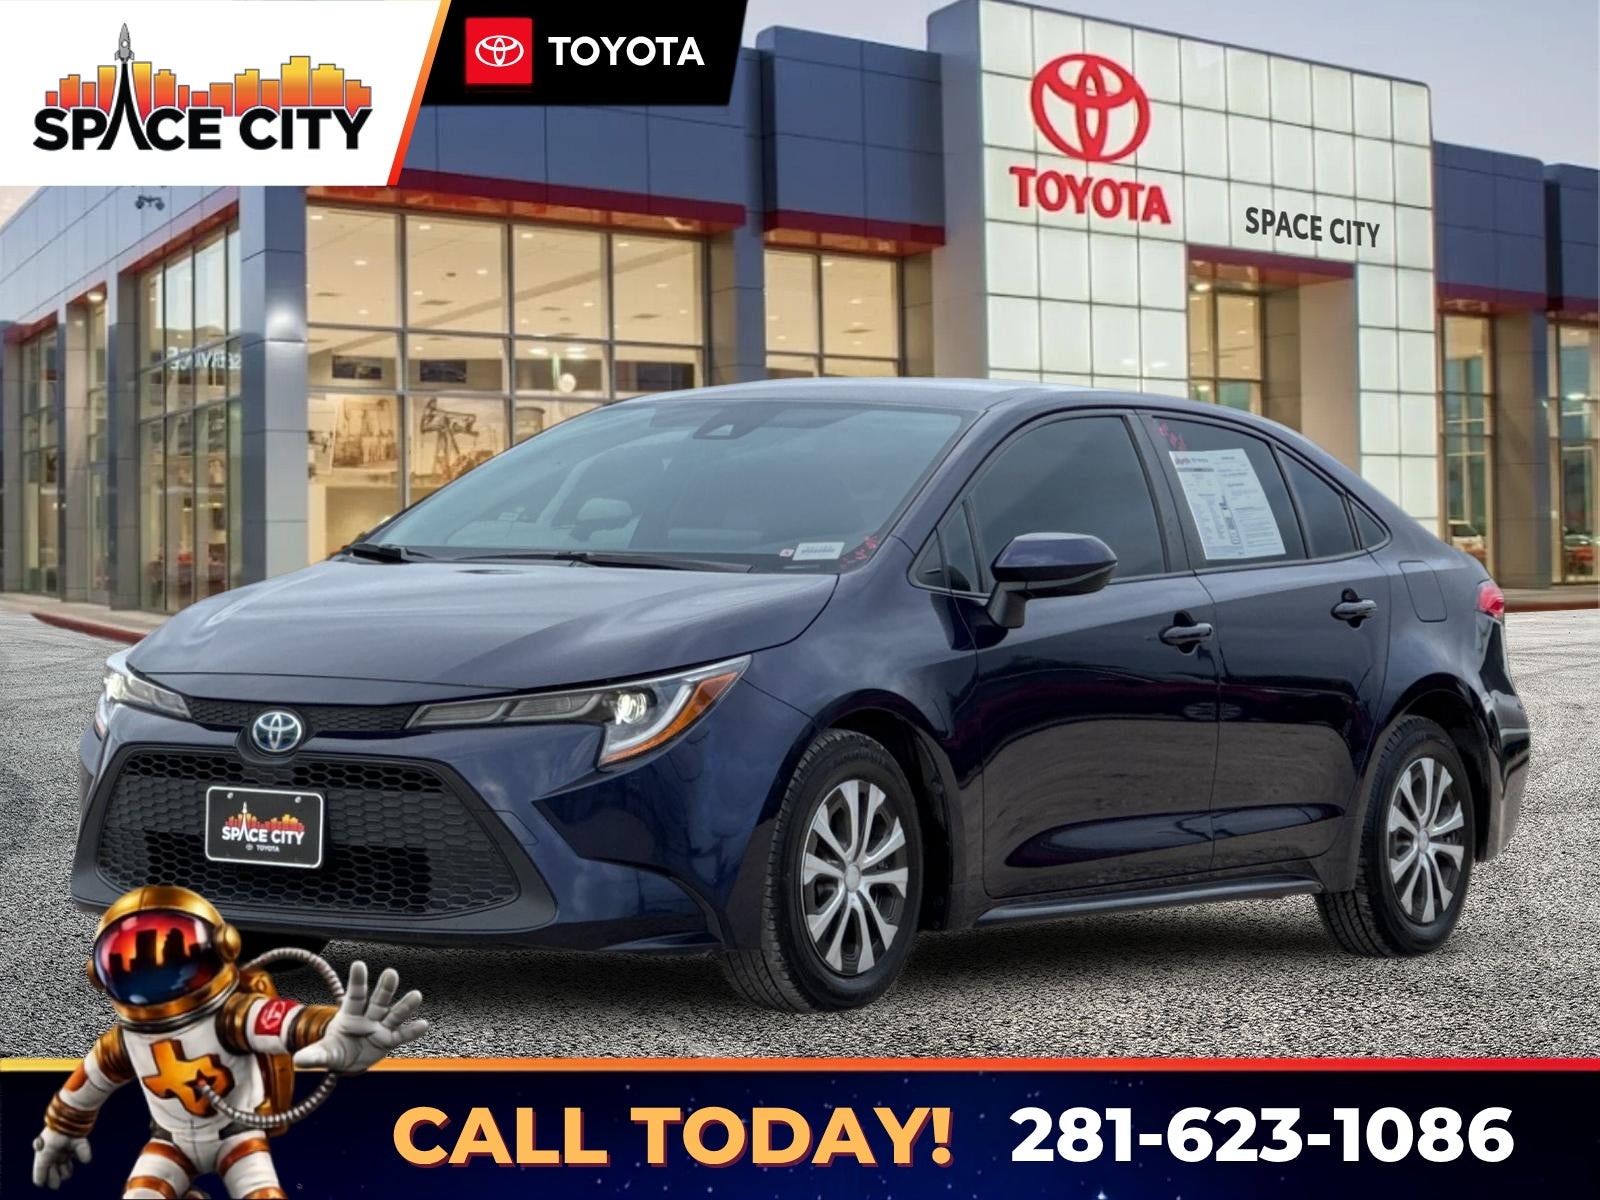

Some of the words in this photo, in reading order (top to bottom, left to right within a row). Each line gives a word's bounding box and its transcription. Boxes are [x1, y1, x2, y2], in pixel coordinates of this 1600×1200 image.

[1009, 166, 1171, 224] TOYOTA
[1245, 206, 1323, 242] SPACE
[1329, 217, 1381, 249] CITY
[221, 825, 268, 843] SPACE
[271, 829, 305, 845] CITY
[256, 844, 280, 852] TOYOTA
